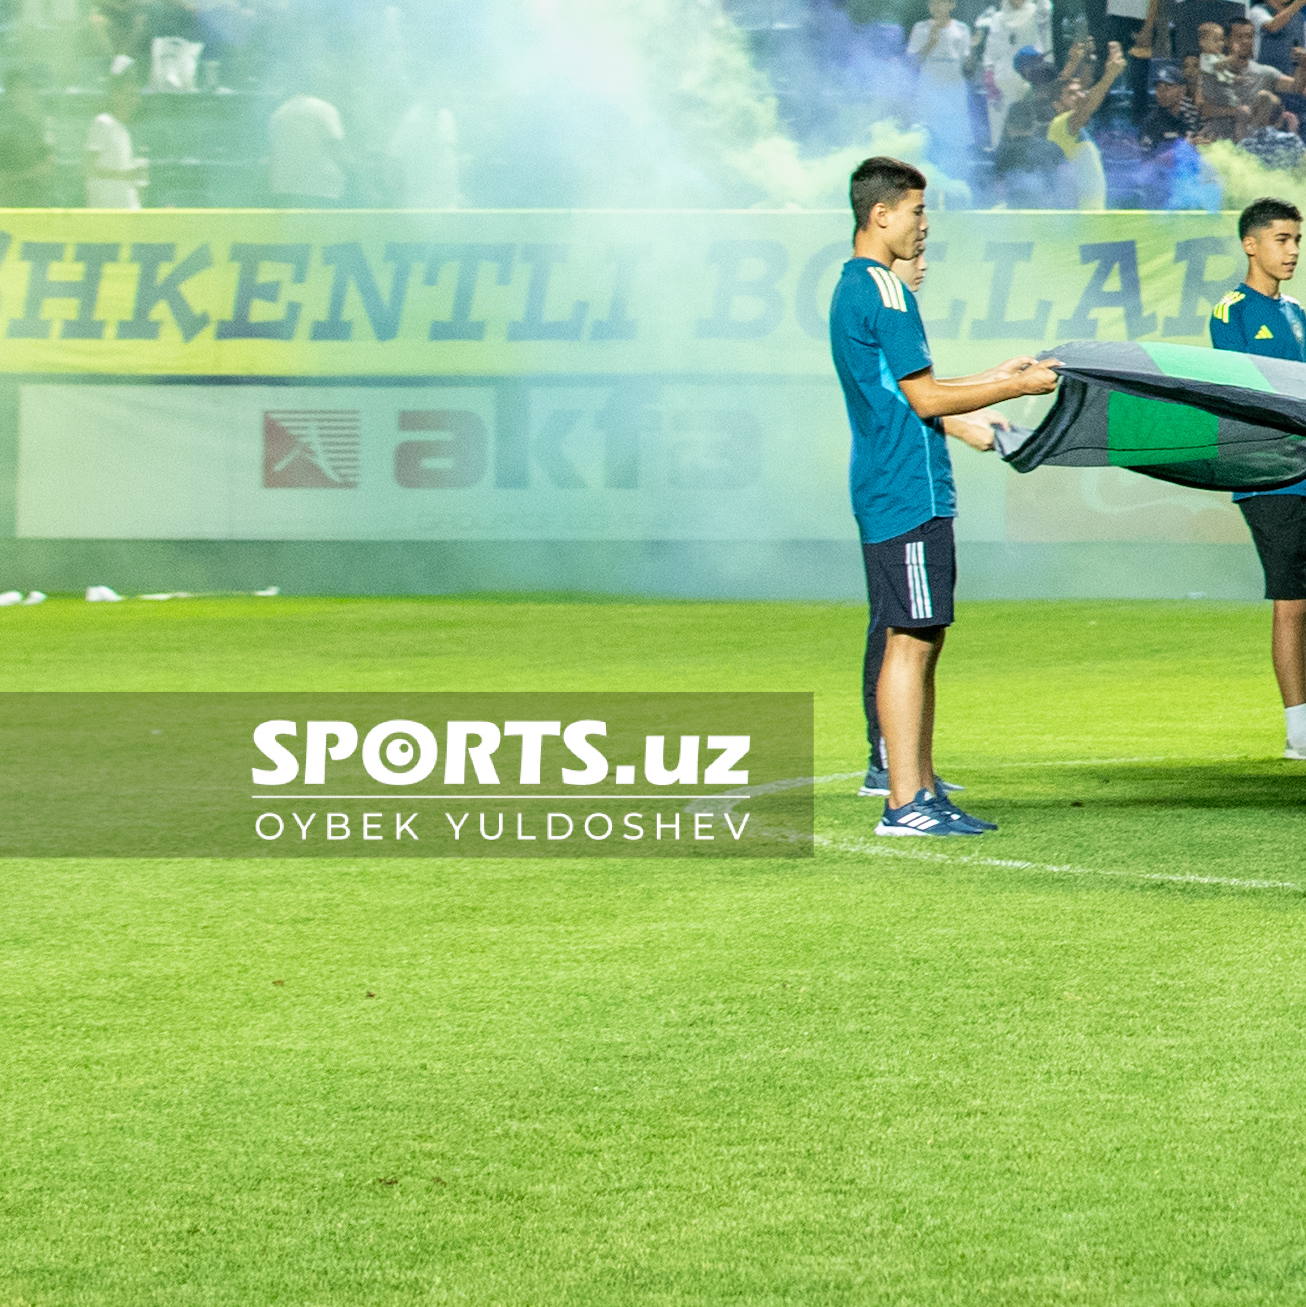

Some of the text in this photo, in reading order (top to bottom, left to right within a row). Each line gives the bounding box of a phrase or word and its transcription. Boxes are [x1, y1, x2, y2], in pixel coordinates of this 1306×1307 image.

[0, 230, 1243, 345] HKENTLI BLAR
[392, 383, 763, 490] akfa
